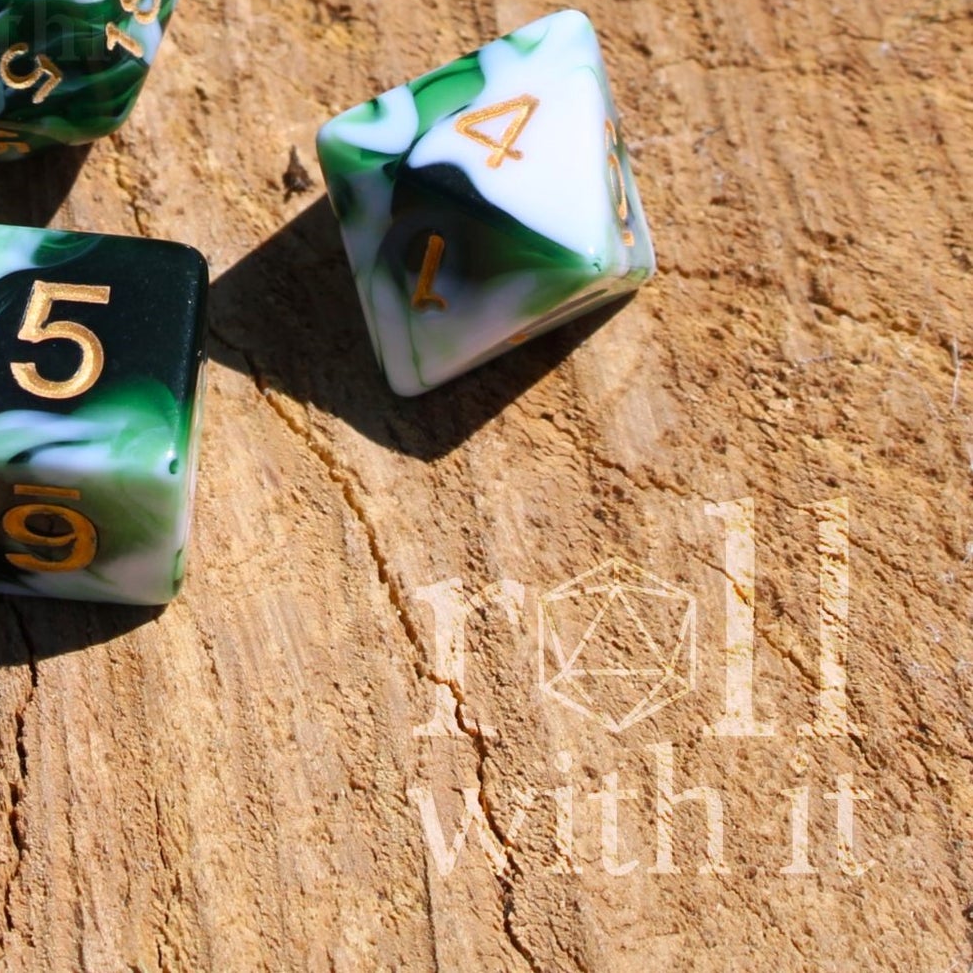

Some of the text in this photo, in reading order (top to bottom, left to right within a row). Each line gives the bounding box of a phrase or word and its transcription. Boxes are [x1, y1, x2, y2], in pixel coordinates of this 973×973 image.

[454, 93, 541, 170] 4
[411, 233, 449, 313] 1
[9, 279, 111, 400] 5
